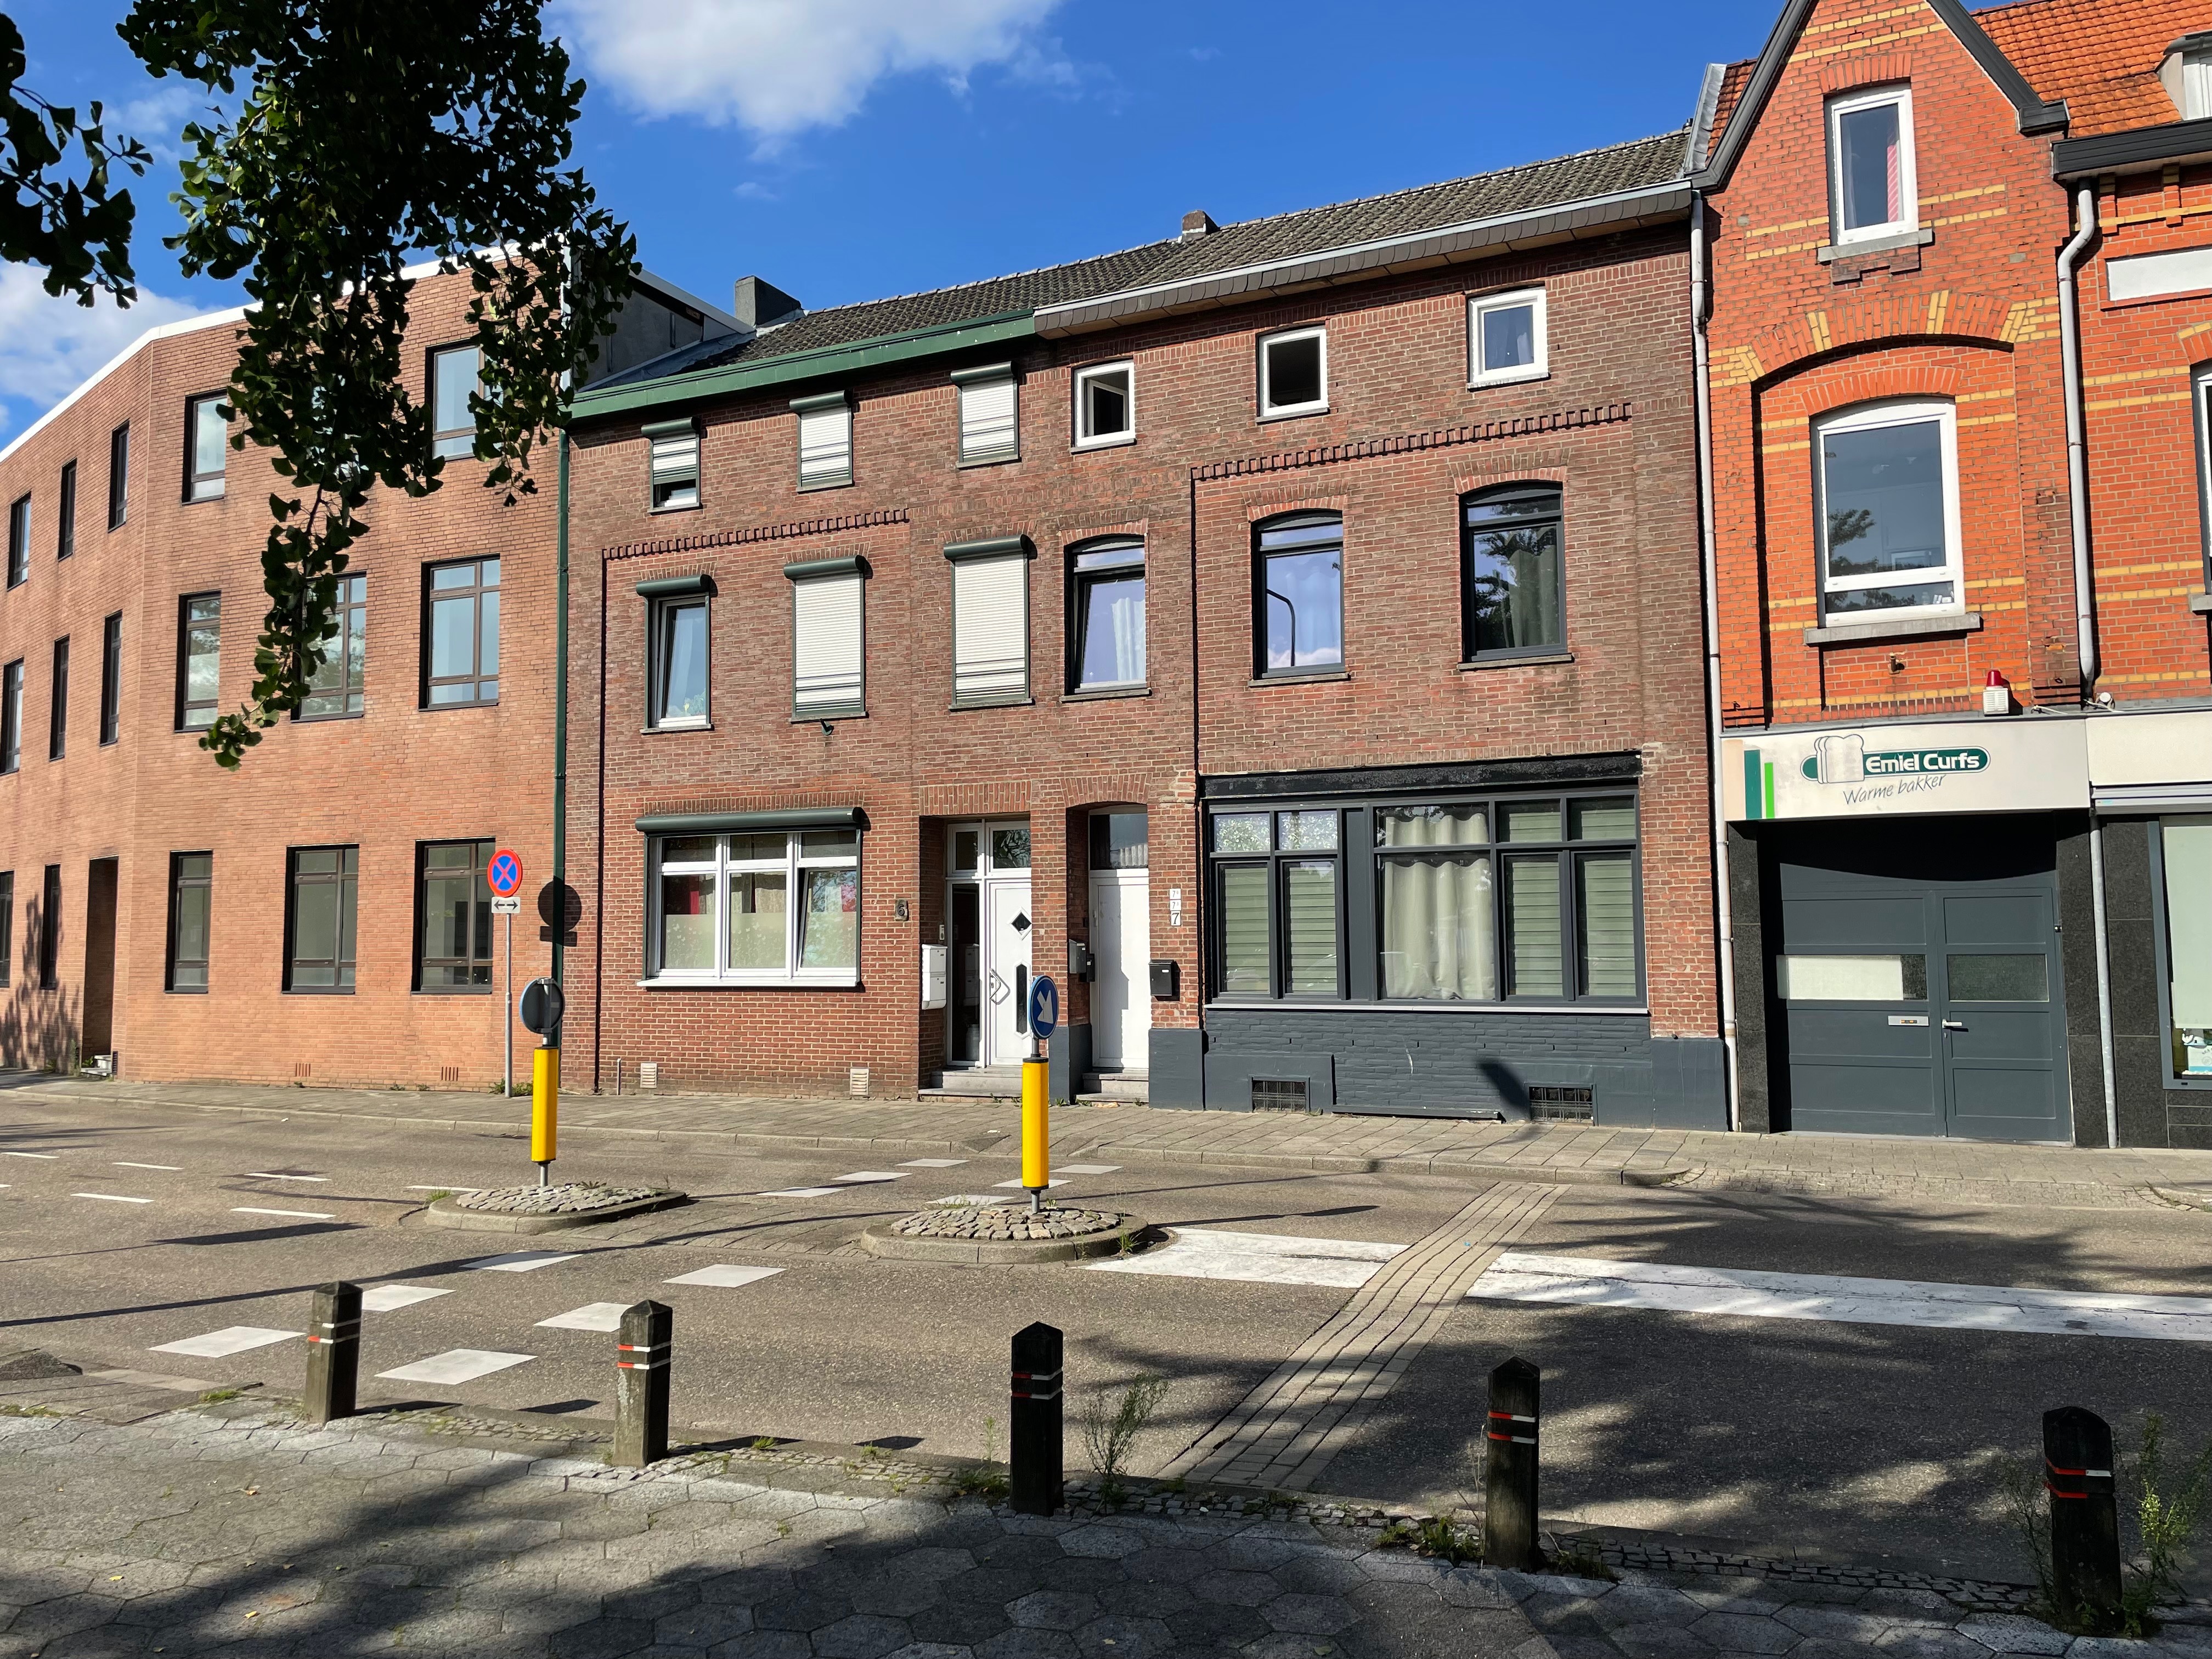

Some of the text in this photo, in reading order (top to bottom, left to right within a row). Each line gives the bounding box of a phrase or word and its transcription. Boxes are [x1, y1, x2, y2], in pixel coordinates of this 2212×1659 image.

[1866, 752, 1980, 773] Emiel Curfs
[1843, 774, 1946, 805] Warme bakker
[898, 904, 905, 916] 6
[1172, 912, 1180, 925] 7
